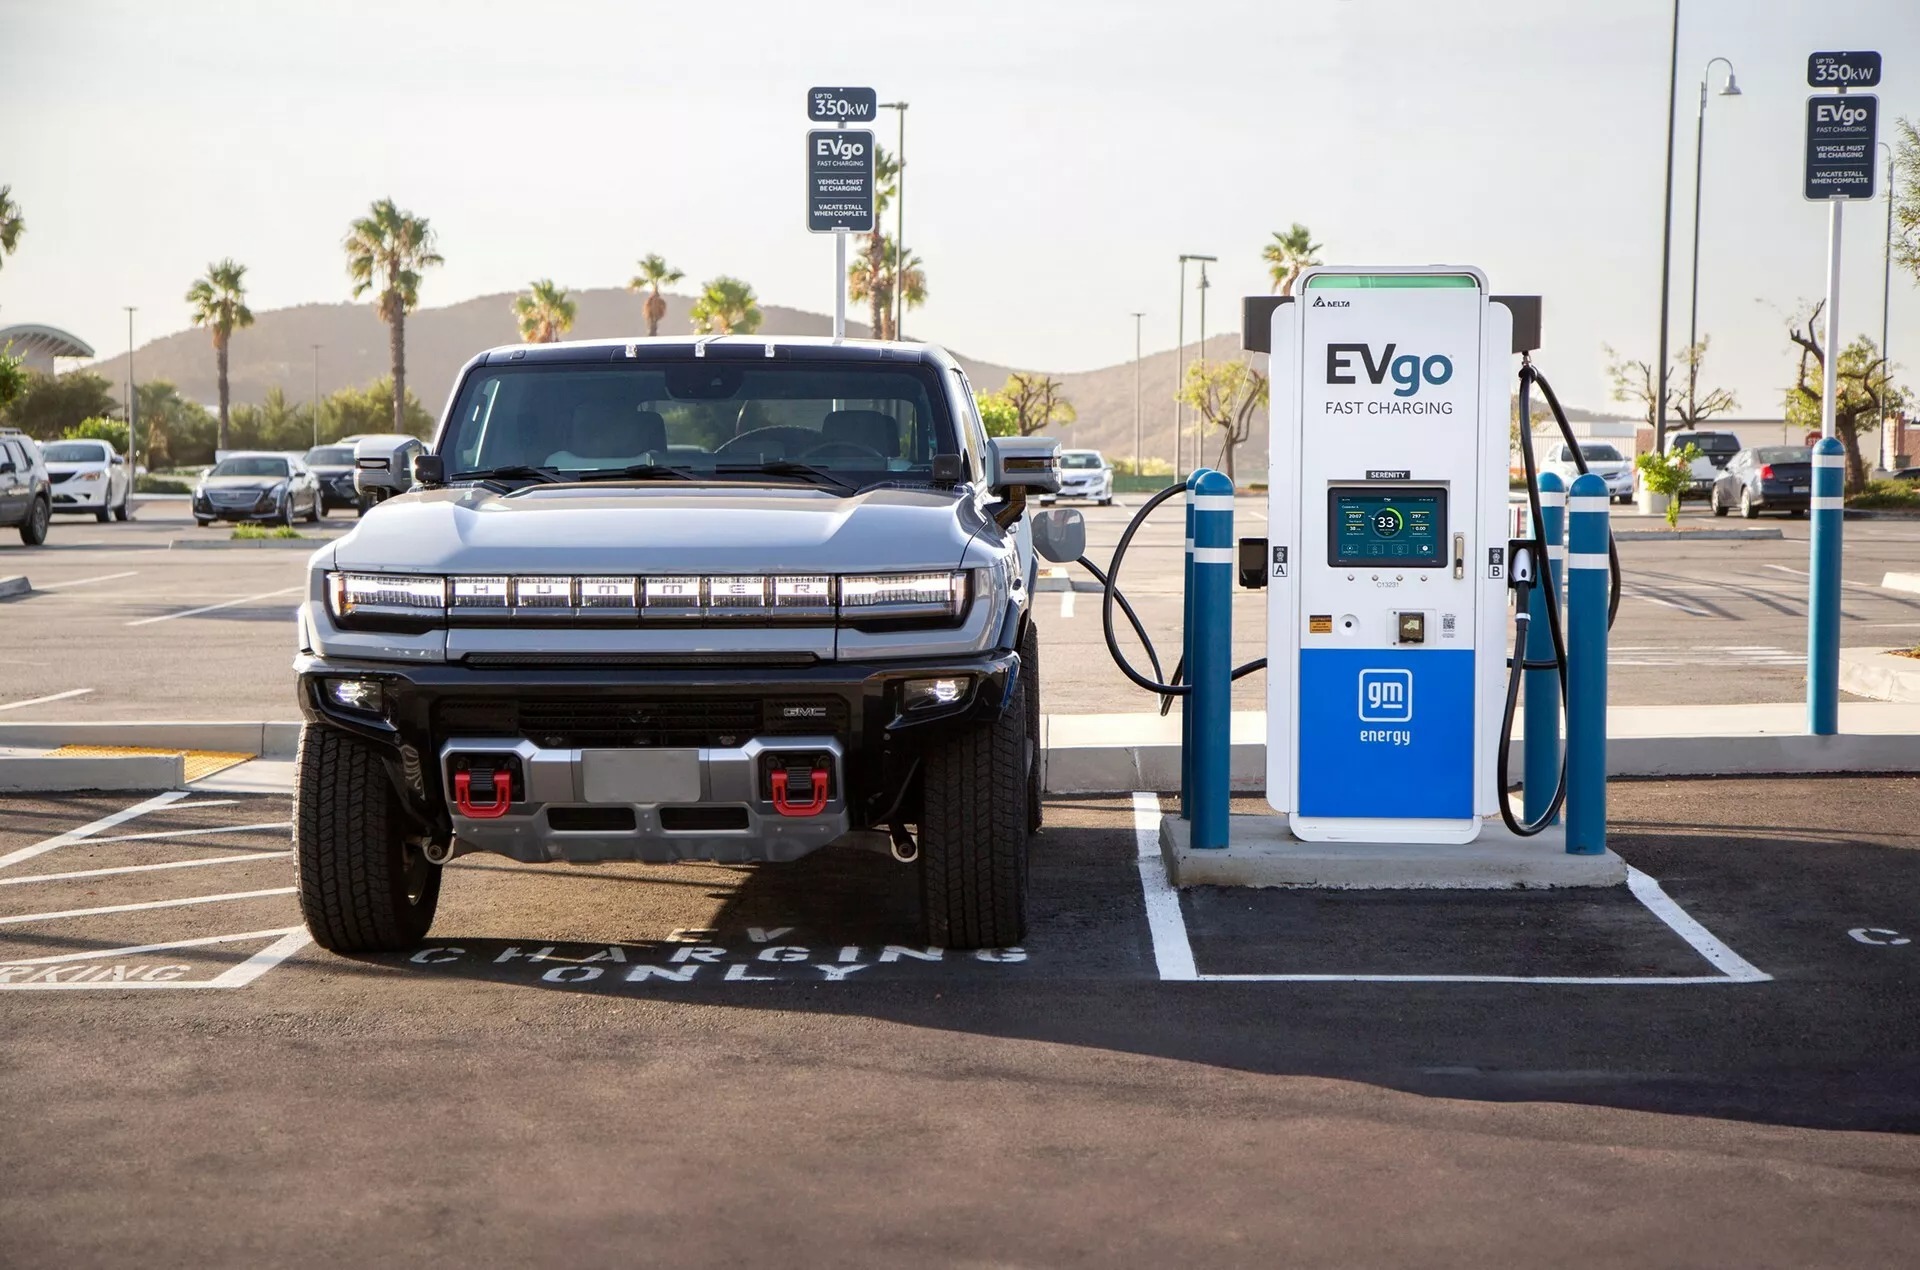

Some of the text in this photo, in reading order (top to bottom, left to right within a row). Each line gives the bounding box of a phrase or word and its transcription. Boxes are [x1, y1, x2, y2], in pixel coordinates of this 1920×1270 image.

[1815, 64, 1873, 81] 350kW
[815, 100, 869, 115] 350kW
[1817, 104, 1867, 125] EVgo
[817, 139, 864, 160] EVgo
[1326, 343, 1454, 397] EVgo
[1325, 401, 1453, 415] FAST CHARGING
[1370, 471, 1406, 479] SERENITY
[1275, 564, 1285, 575] A
[1492, 566, 1501, 577] B
[1368, 681, 1403, 709] gm
[784, 707, 827, 717] GMC
[1360, 730, 1410, 746] energy
[409, 946, 1028, 964] CHARGING
[541, 964, 871, 983] ONLY
